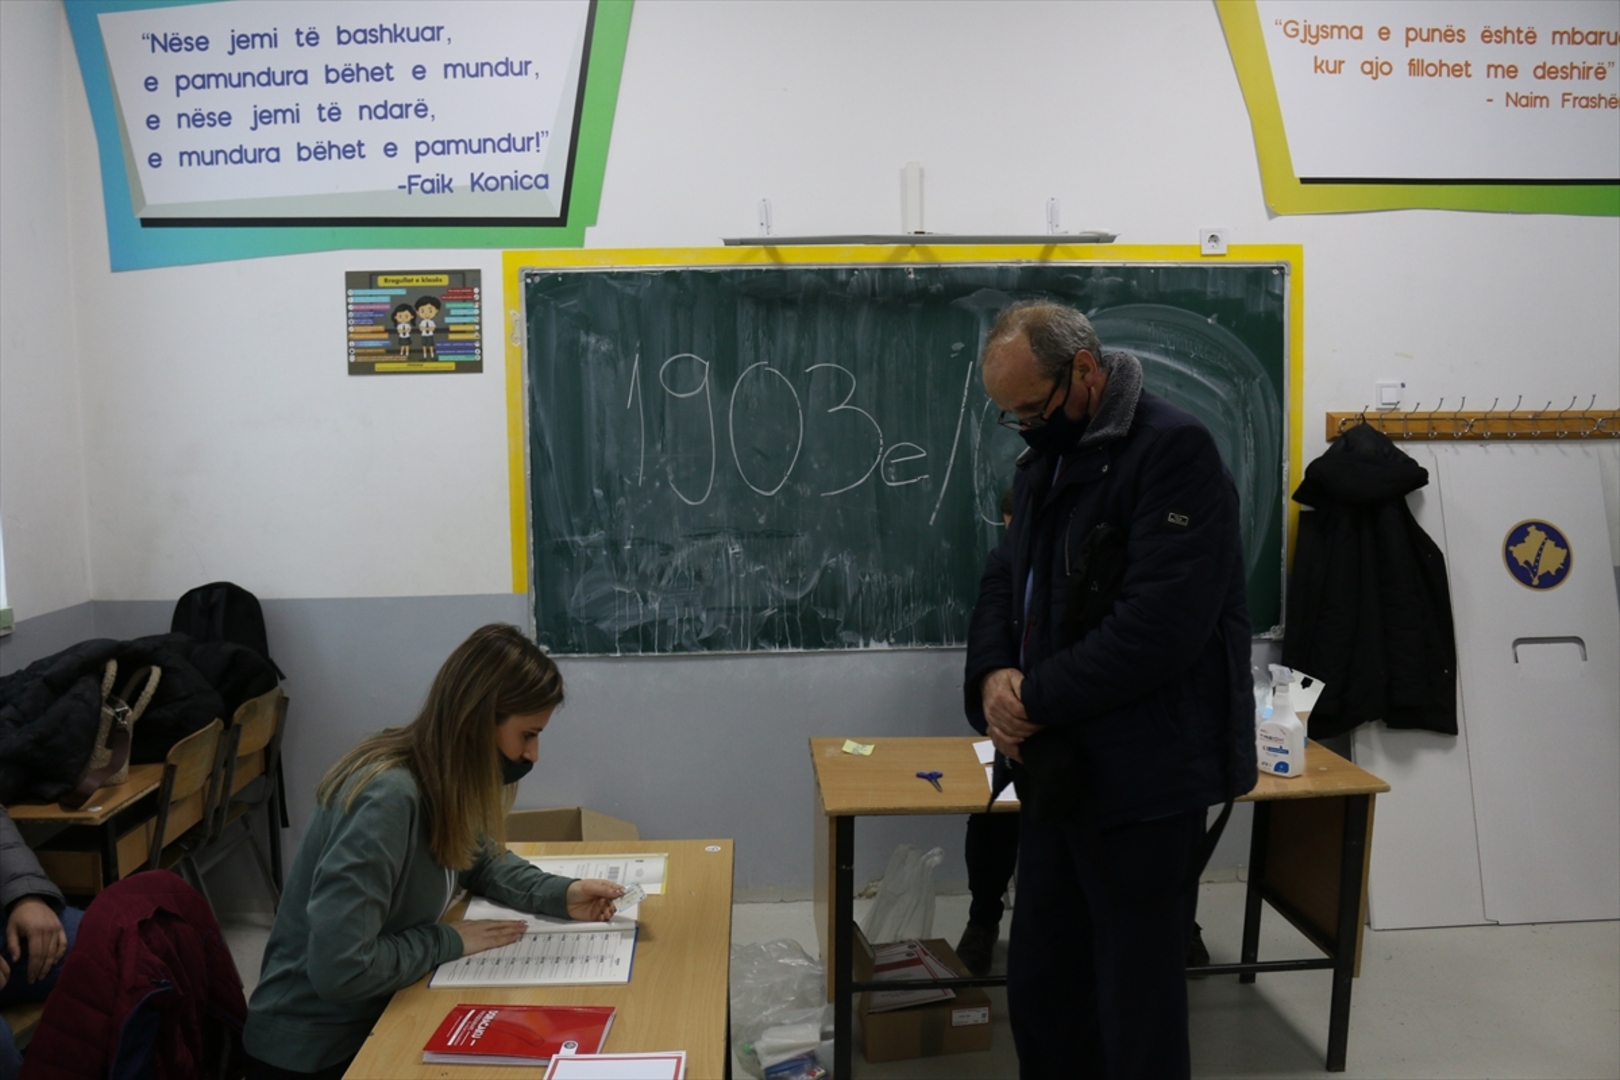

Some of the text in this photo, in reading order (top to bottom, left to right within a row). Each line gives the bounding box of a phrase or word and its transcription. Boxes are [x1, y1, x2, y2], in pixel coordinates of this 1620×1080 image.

[142, 23, 451, 55] “Nëse jemi të bashkuar,
[1275, 20, 1620, 48] “Gjysma e punës është mbaru
[144, 57, 538, 97] e pamundura bëhet e mundur,
[1314, 55, 1615, 81] kur ajo fillohet me deshirë”
[146, 99, 434, 131] e nëse jemi të ndarë,
[1506, 92, 1549, 108] Naim
[1562, 93, 1620, 109] Frashë
[148, 131, 548, 168] e mundura bëhet e pamundur!”
[398, 170, 549, 195] -Faik Konica
